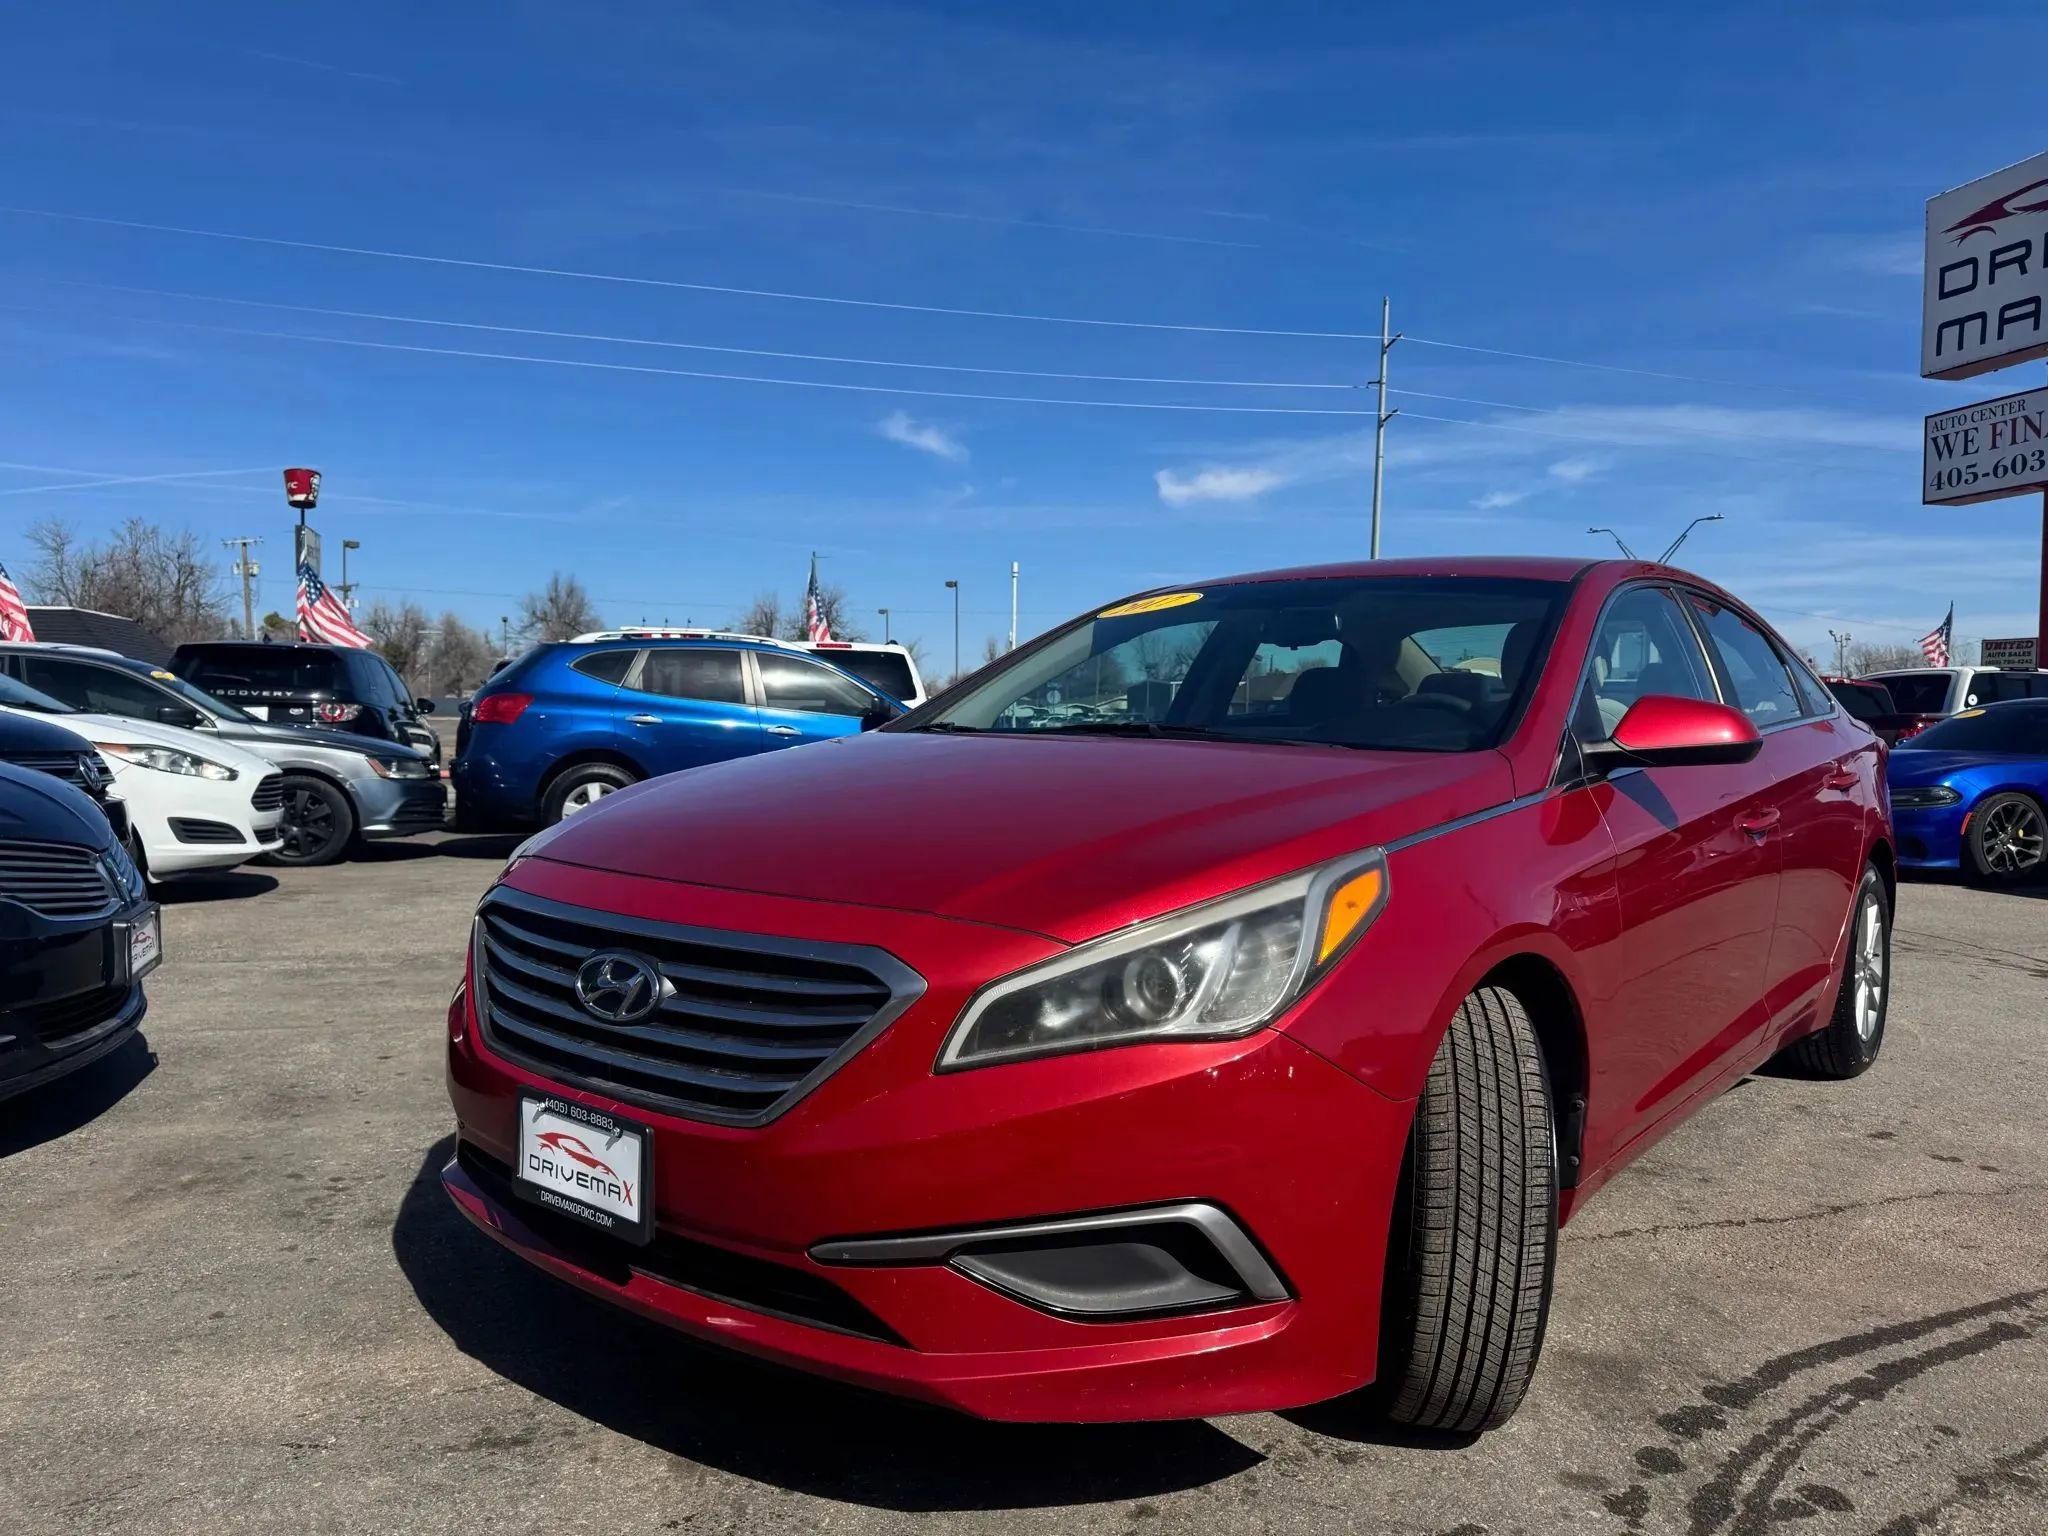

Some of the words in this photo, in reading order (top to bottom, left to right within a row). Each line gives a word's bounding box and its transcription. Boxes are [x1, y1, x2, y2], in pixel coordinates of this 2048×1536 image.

[1936, 295, 2042, 357] MA
[1930, 427, 1980, 462] WE
[1989, 410, 2048, 451] FIN
[1931, 413, 1967, 433] AUTO
[1970, 399, 2026, 423] CENTER
[1930, 449, 2045, 491] 405-603
[1985, 640, 2034, 651] UNITED
[545, 1098, 568, 1114] (405)
[570, 1106, 614, 1130] 603-8883
[529, 1153, 634, 1207] DRIVEMAX
[540, 1190, 613, 1228] DRIVEMAXOFOKC.COM
